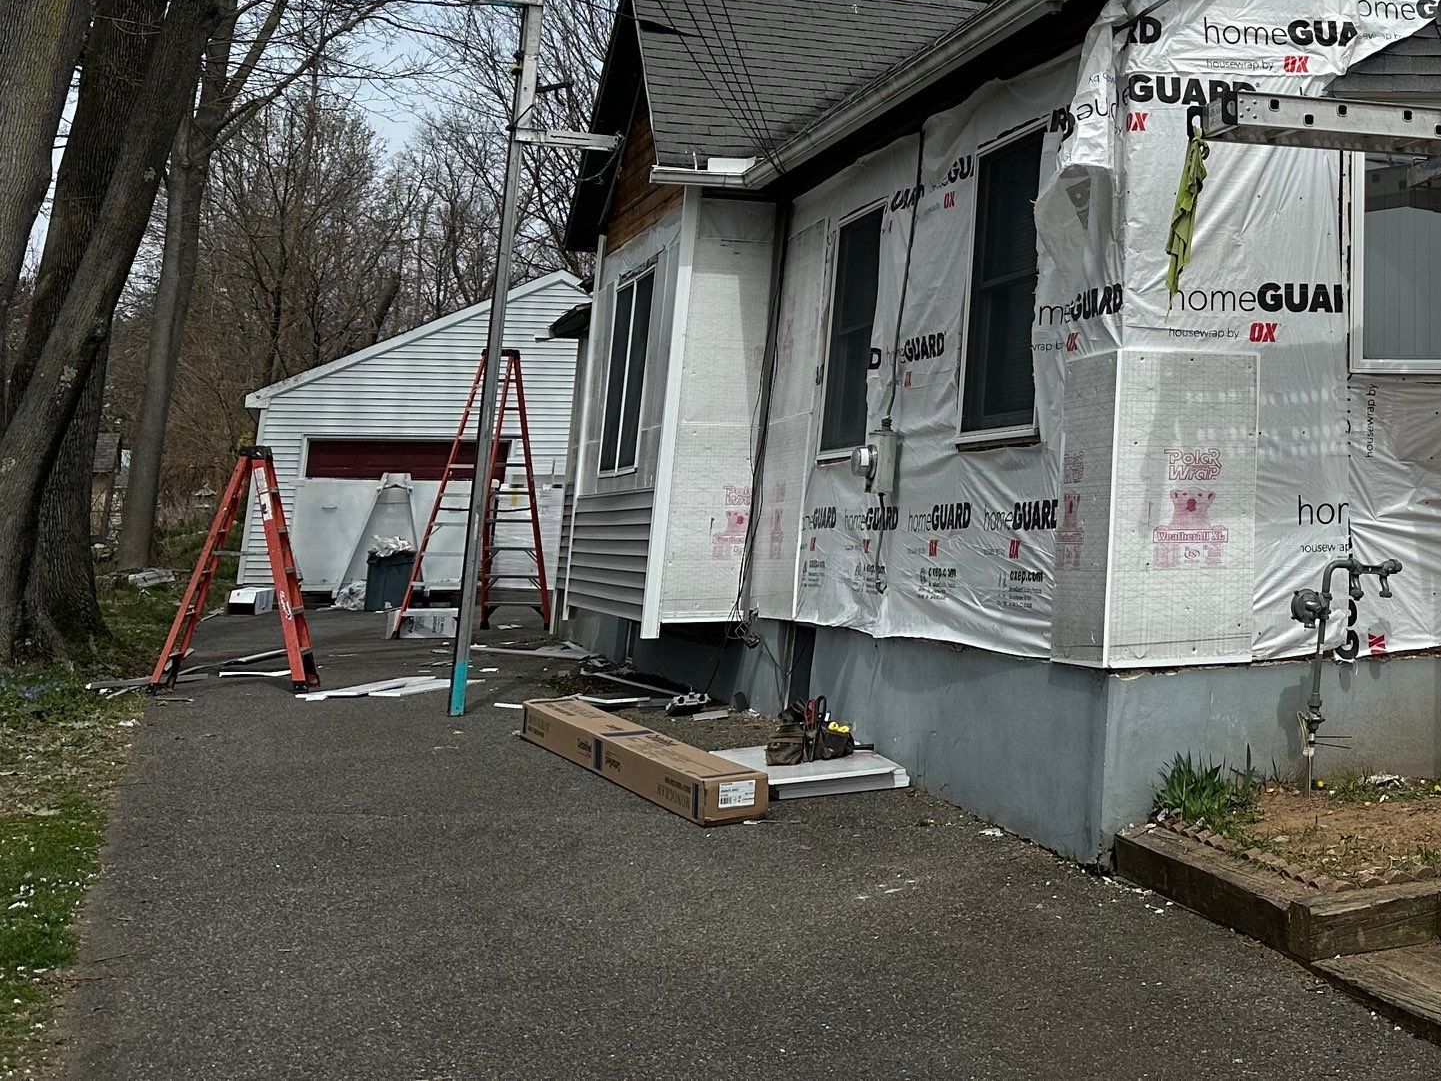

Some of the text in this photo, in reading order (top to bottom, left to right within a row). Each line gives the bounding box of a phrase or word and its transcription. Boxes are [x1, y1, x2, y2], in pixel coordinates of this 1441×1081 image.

[1206, 55, 1309, 73] housewrap by OX
[1169, 323, 1278, 343] housewrap by OX
[1365, 383, 1378, 458] housewrap by
[908, 502, 971, 532] homeGUARD
[1009, 539, 1021, 559] OX
